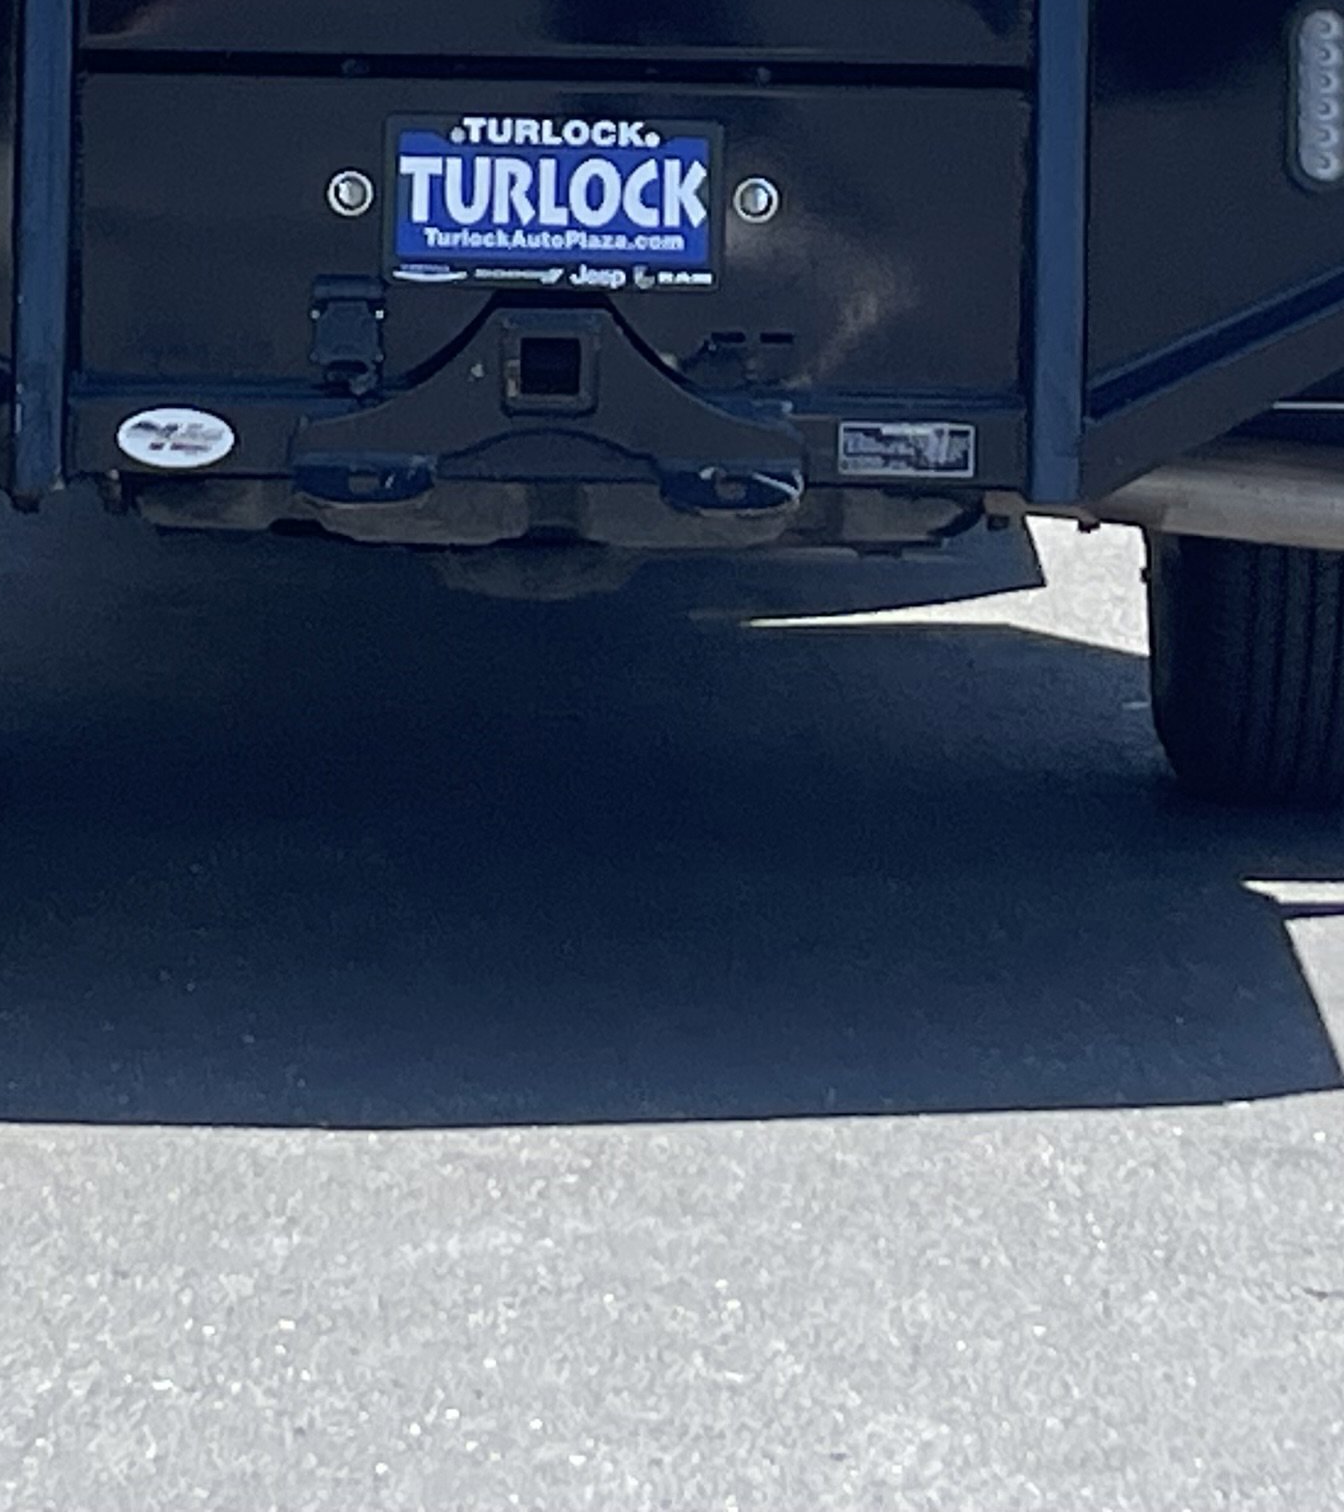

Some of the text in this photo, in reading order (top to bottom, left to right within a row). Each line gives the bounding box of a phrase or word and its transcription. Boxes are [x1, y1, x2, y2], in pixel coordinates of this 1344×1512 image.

[462, 117, 645, 147] TURLOCK
[399, 155, 707, 228] TURLOCK
[423, 227, 686, 251] TurlockAutoPlaza.com
[569, 264, 627, 289] Jeep
